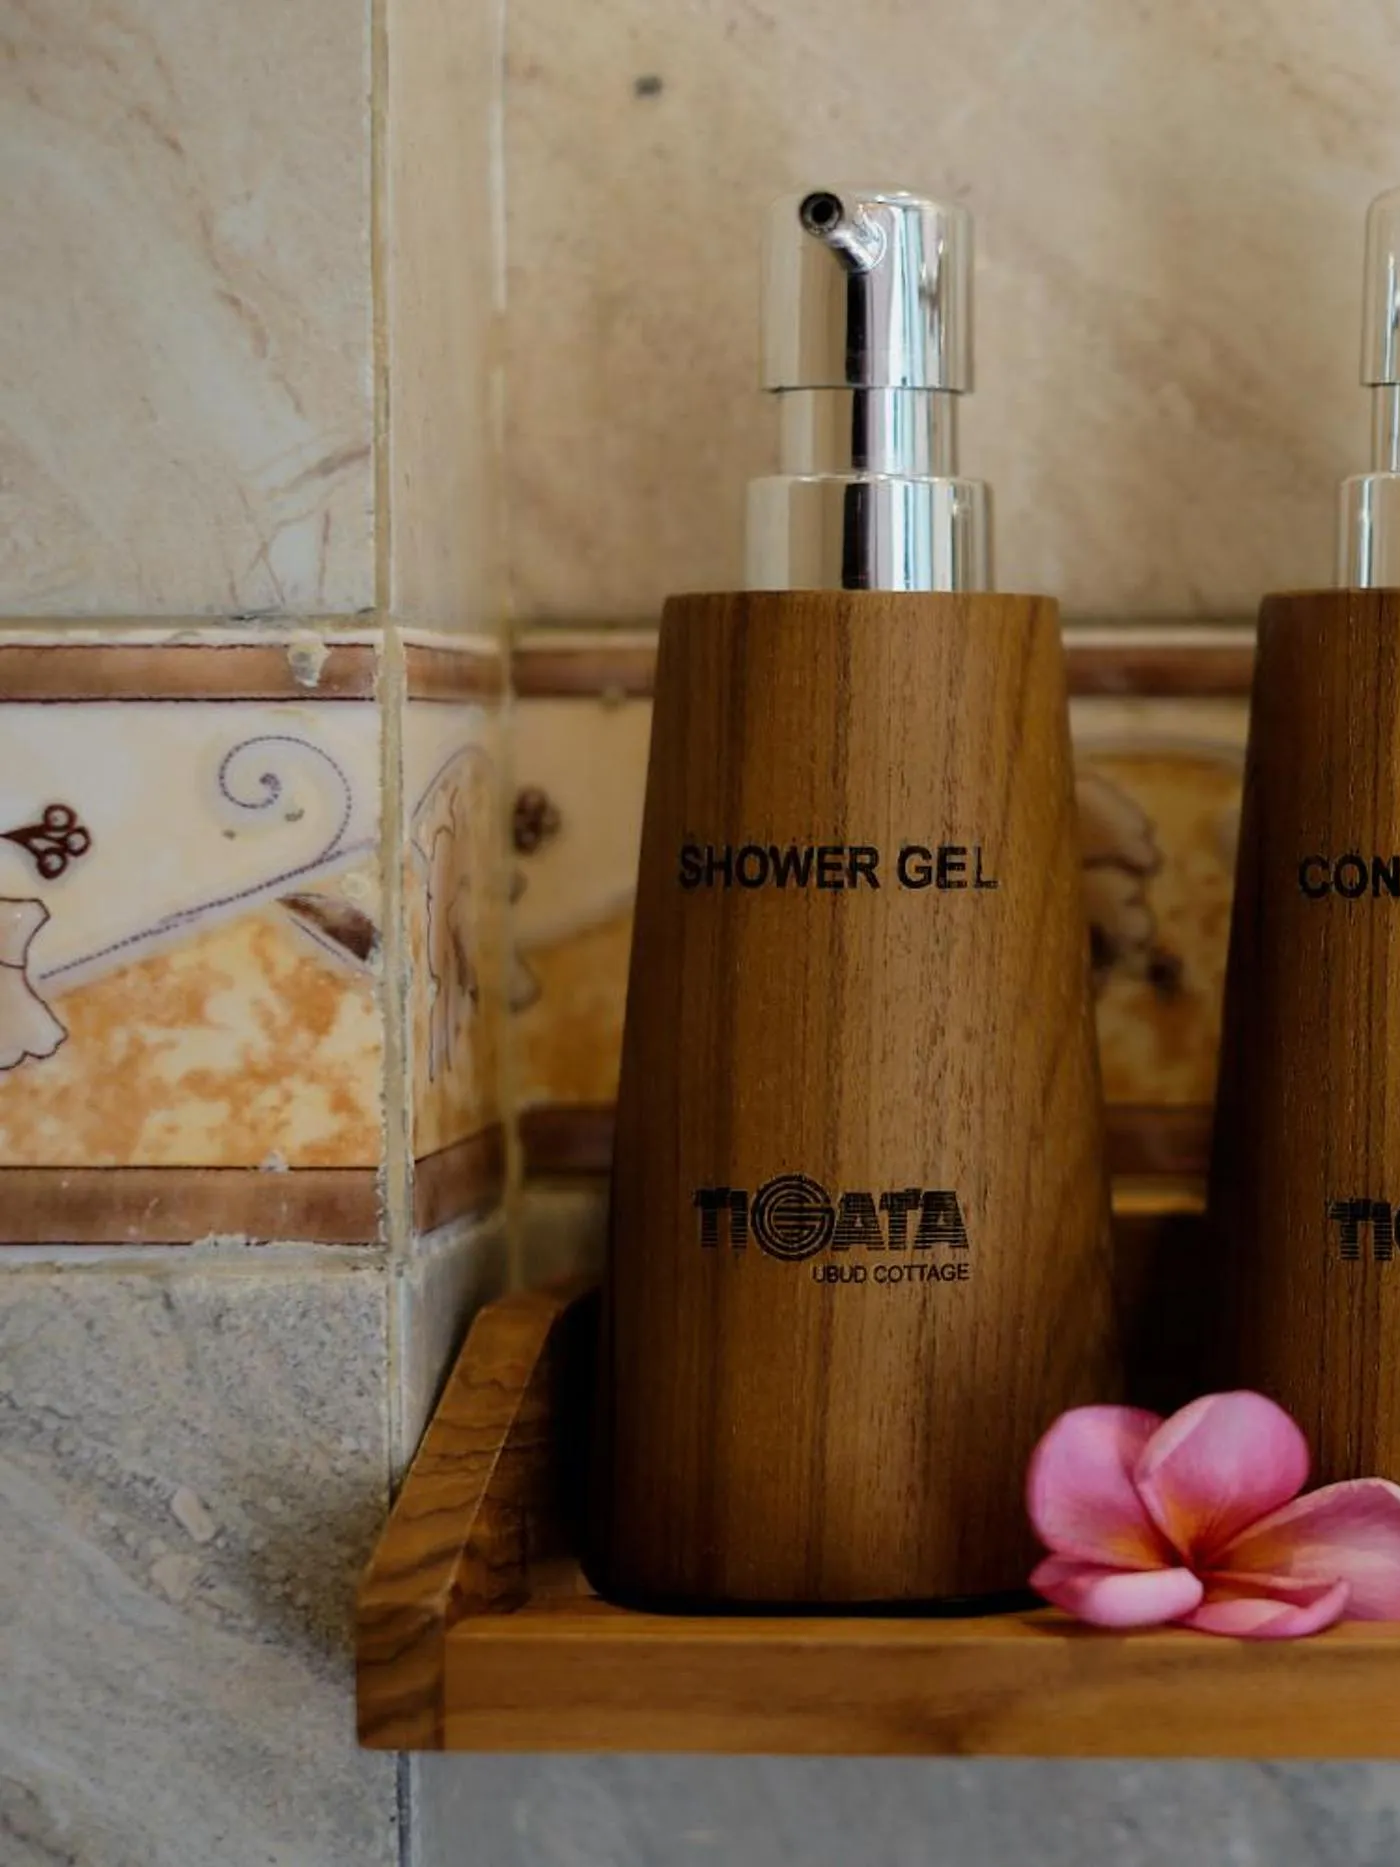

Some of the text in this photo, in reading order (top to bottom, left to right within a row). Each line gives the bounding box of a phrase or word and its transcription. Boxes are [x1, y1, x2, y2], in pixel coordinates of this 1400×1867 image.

[678, 844, 998, 890] SHOWER GEL
[693, 1172, 970, 1262] TIGATA
[812, 1263, 970, 1284] UBUD COTTAGE
